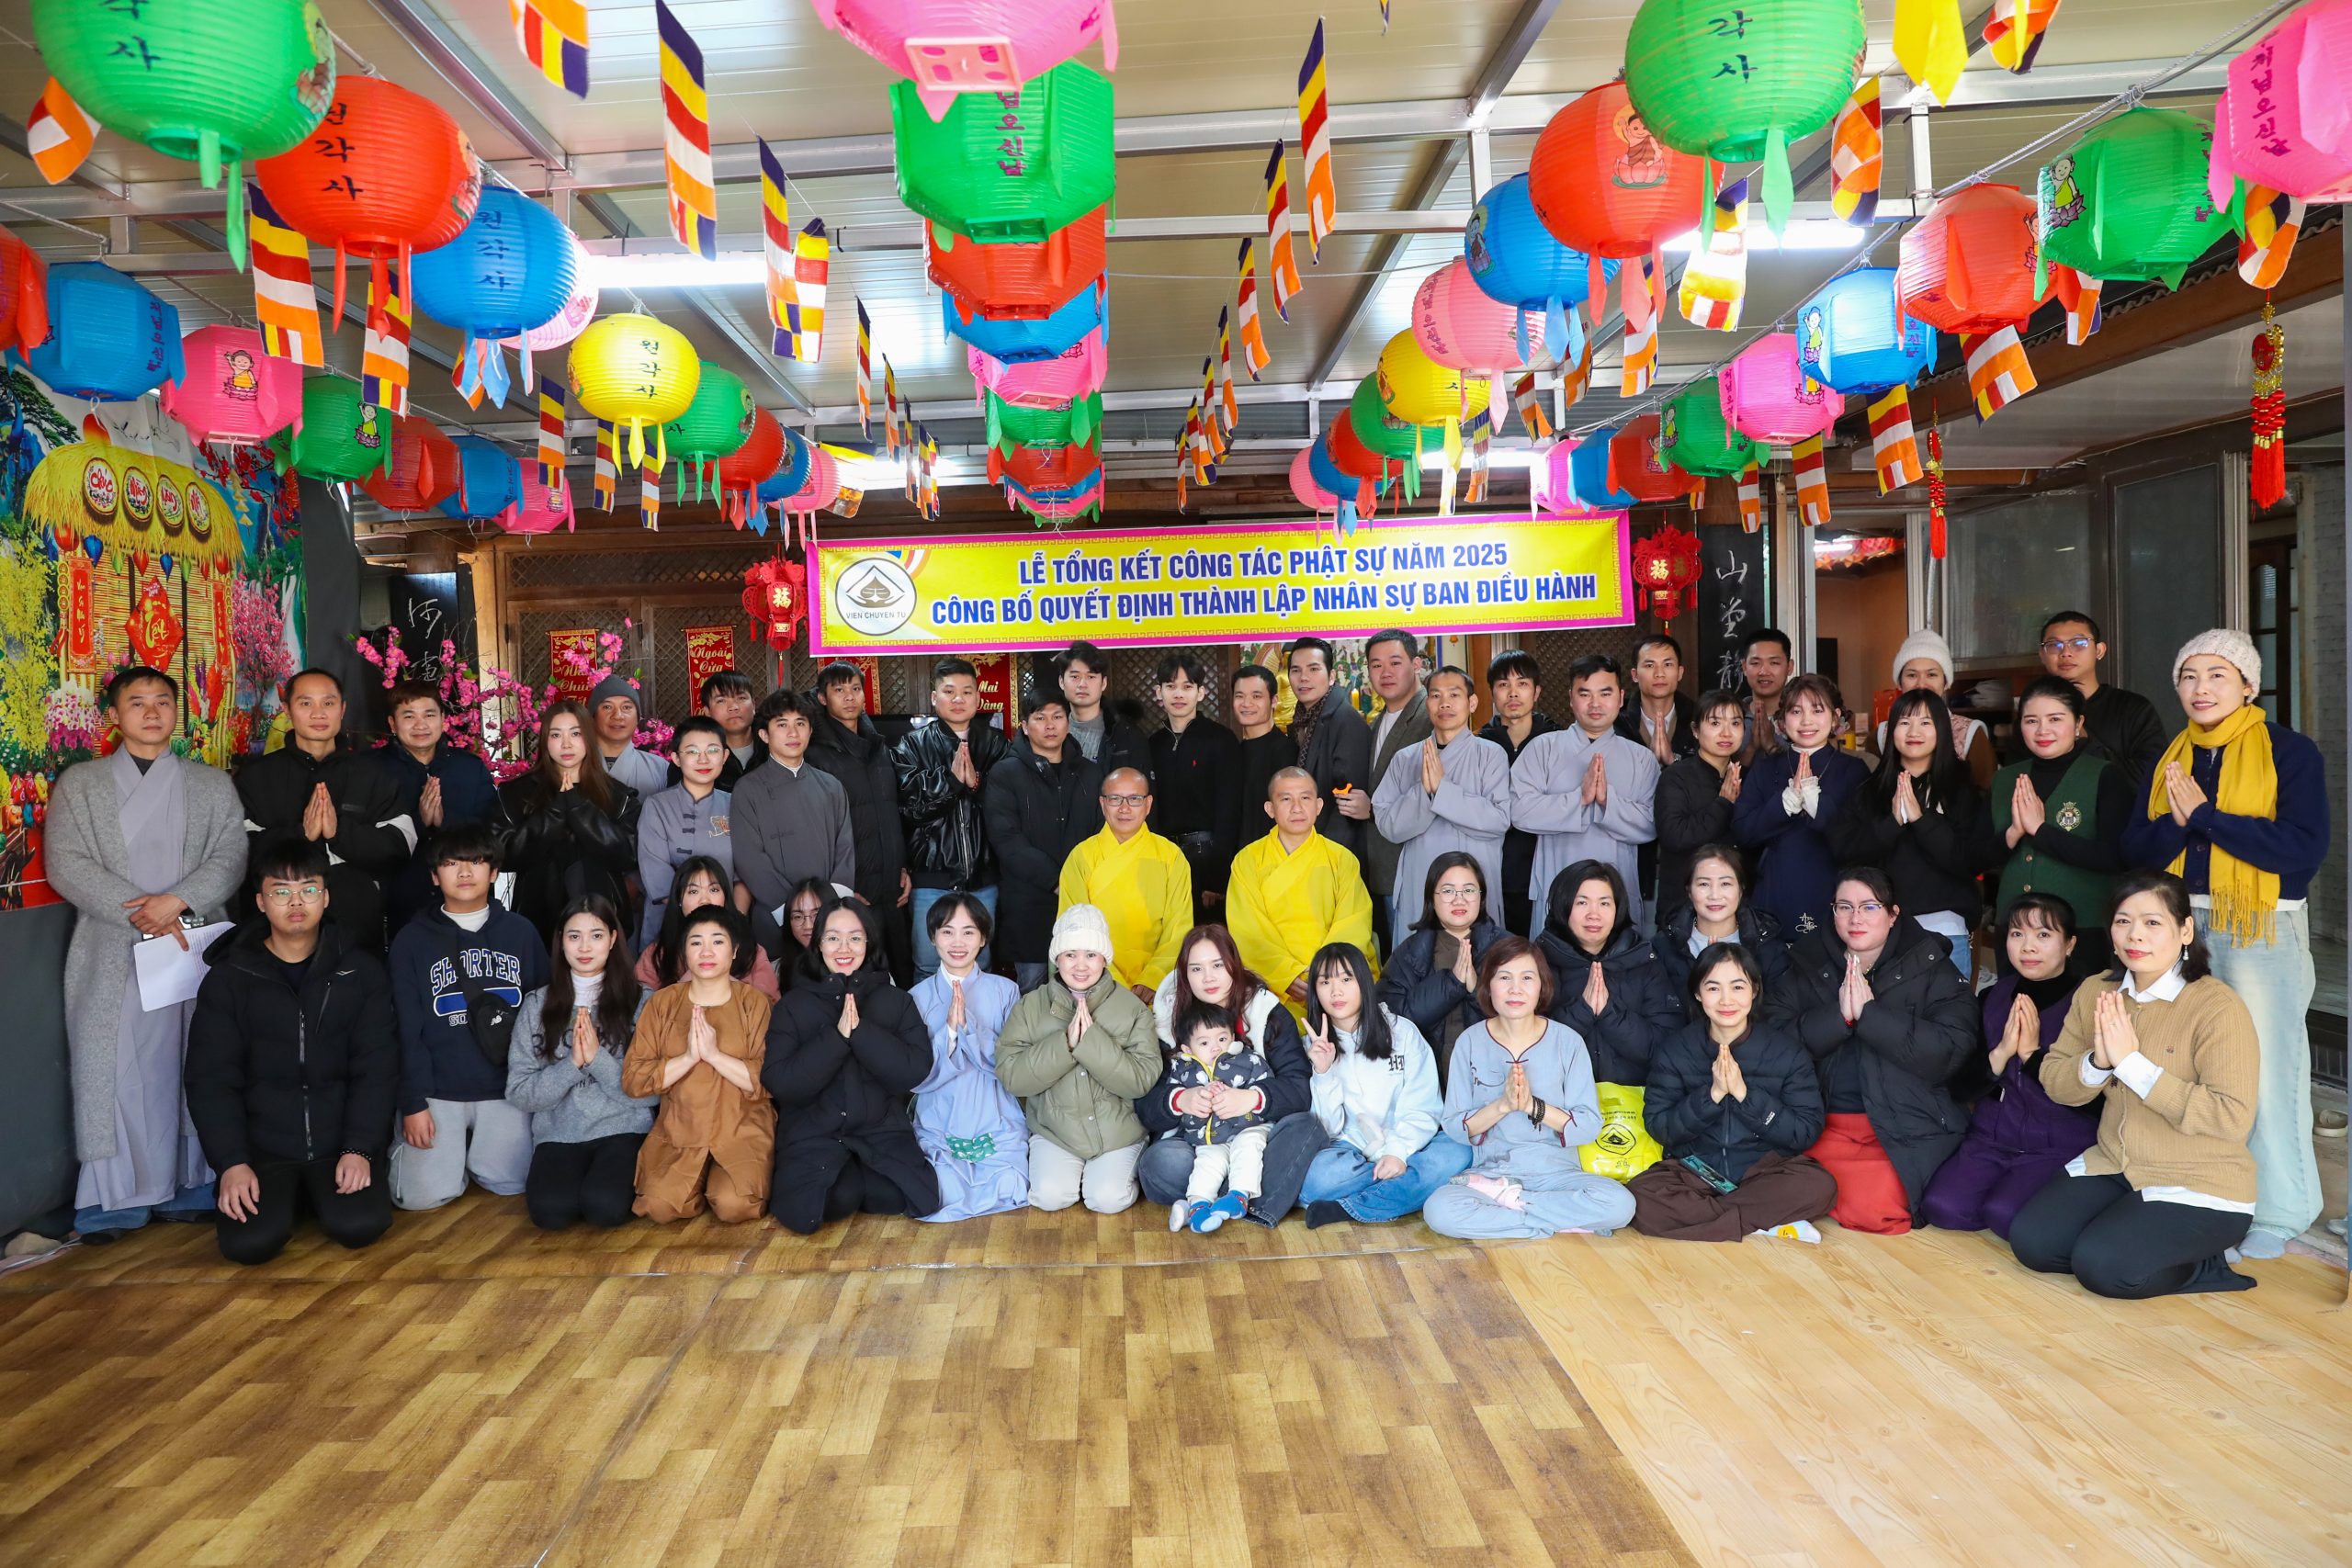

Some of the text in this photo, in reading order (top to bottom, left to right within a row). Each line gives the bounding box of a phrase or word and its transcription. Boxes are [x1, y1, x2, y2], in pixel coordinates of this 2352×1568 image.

[1021, 542, 1508, 584] LỄ TỔNG KẾT CÔNG TÁC PHẬT SỰ NĂM 2025
[1651, 558, 1669, 580] 福
[773, 587, 792, 609] 福
[933, 570, 1597, 625] CÔNG BỐ QUYẾT ĐỊNH THÀNH LẬP NHÂN SỰ BAN ĐIỀU HÀNH
[560, 679, 594, 693] Chú
[978, 680, 999, 693] Mai
